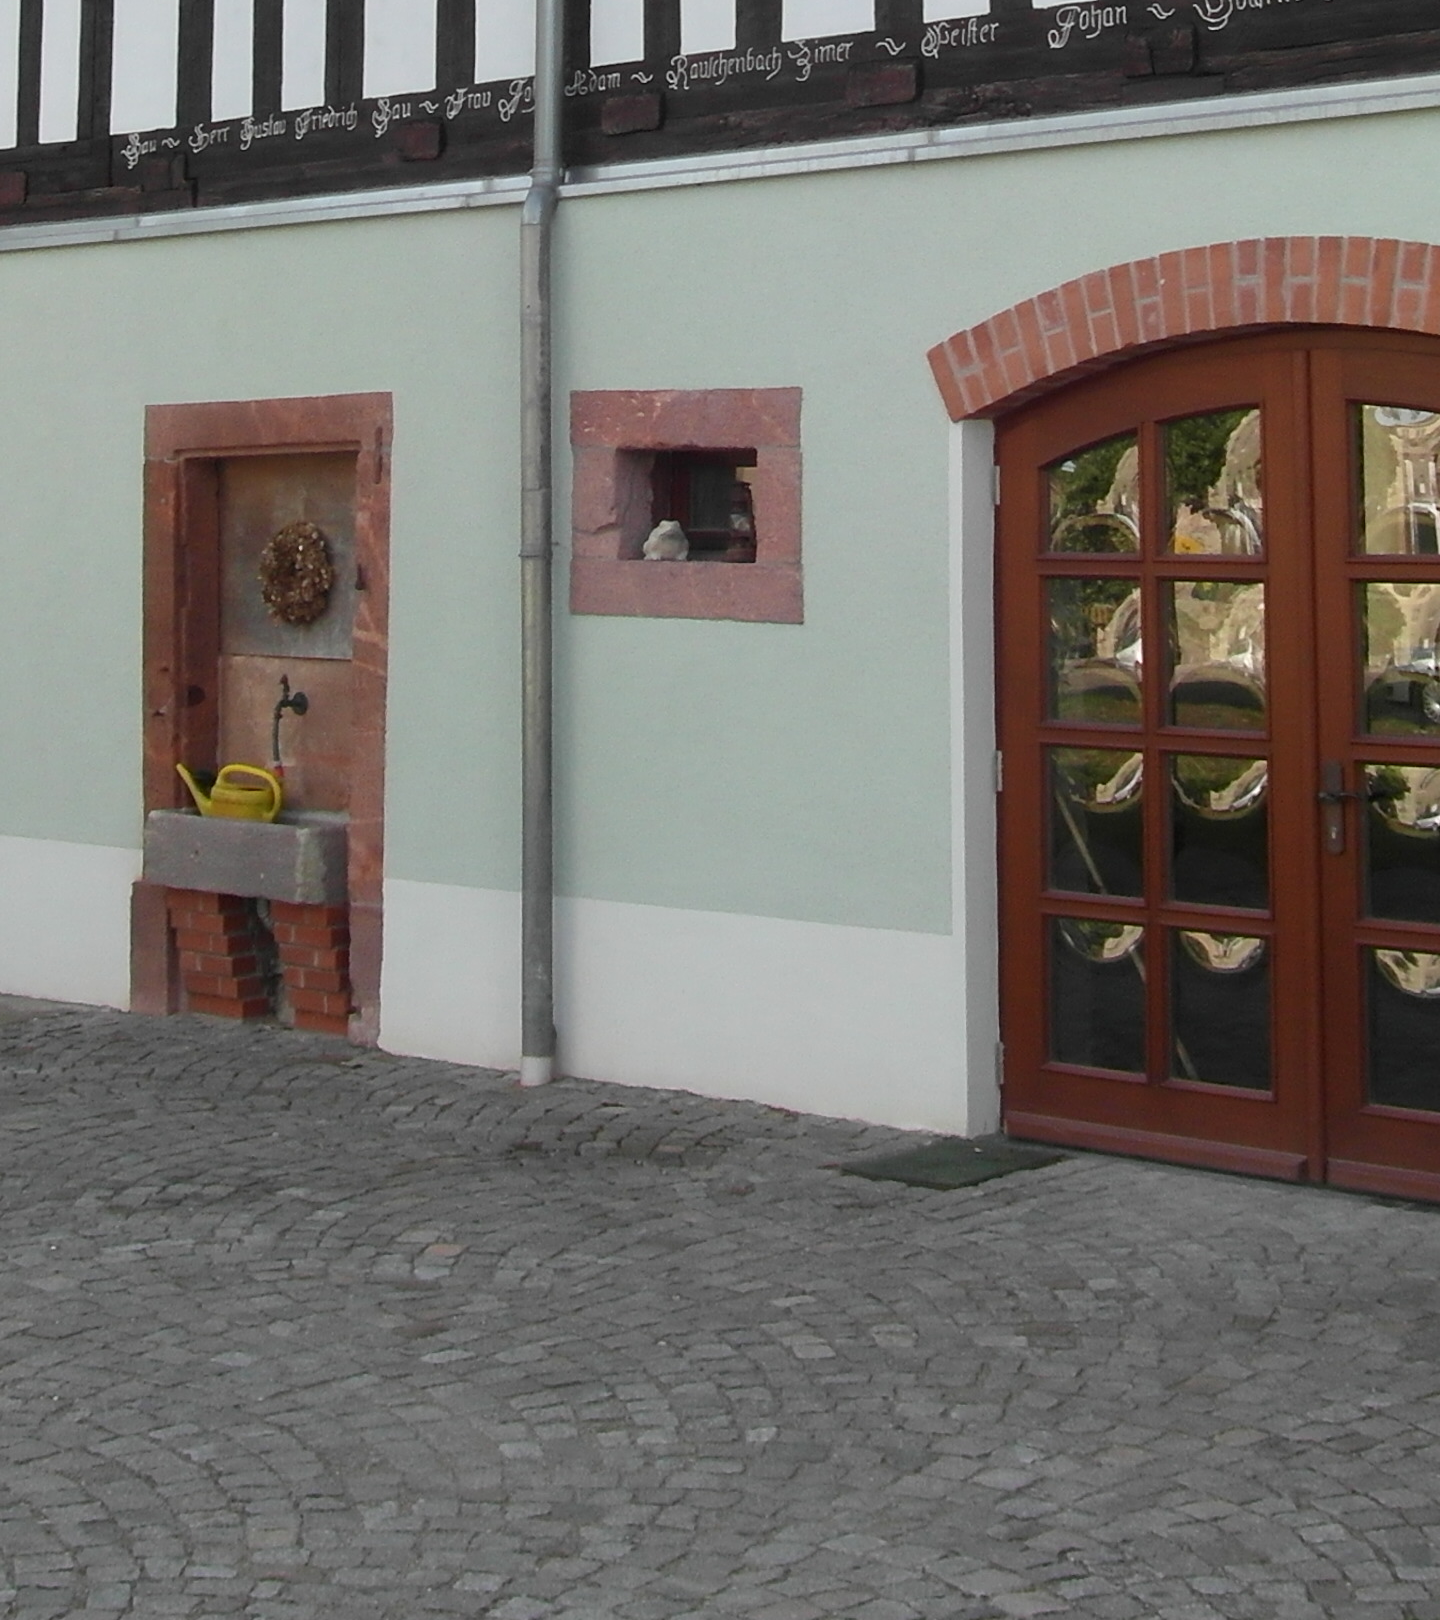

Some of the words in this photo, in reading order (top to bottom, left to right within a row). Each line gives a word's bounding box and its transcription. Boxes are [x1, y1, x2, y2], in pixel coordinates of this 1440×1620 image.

[120, 132, 157, 169] Bau
[188, 123, 230, 154] Herr
[295, 104, 358, 139] Friedrich
[371, 96, 411, 138] Bau
[445, 86, 491, 119] Frau
[498, 78, 536, 122] Jo
[564, 68, 621, 97] Adam
[666, 45, 782, 91] Rauschenbach
[921, 18, 1000, 58] Meister
[1048, 2, 1128, 48] Johan
